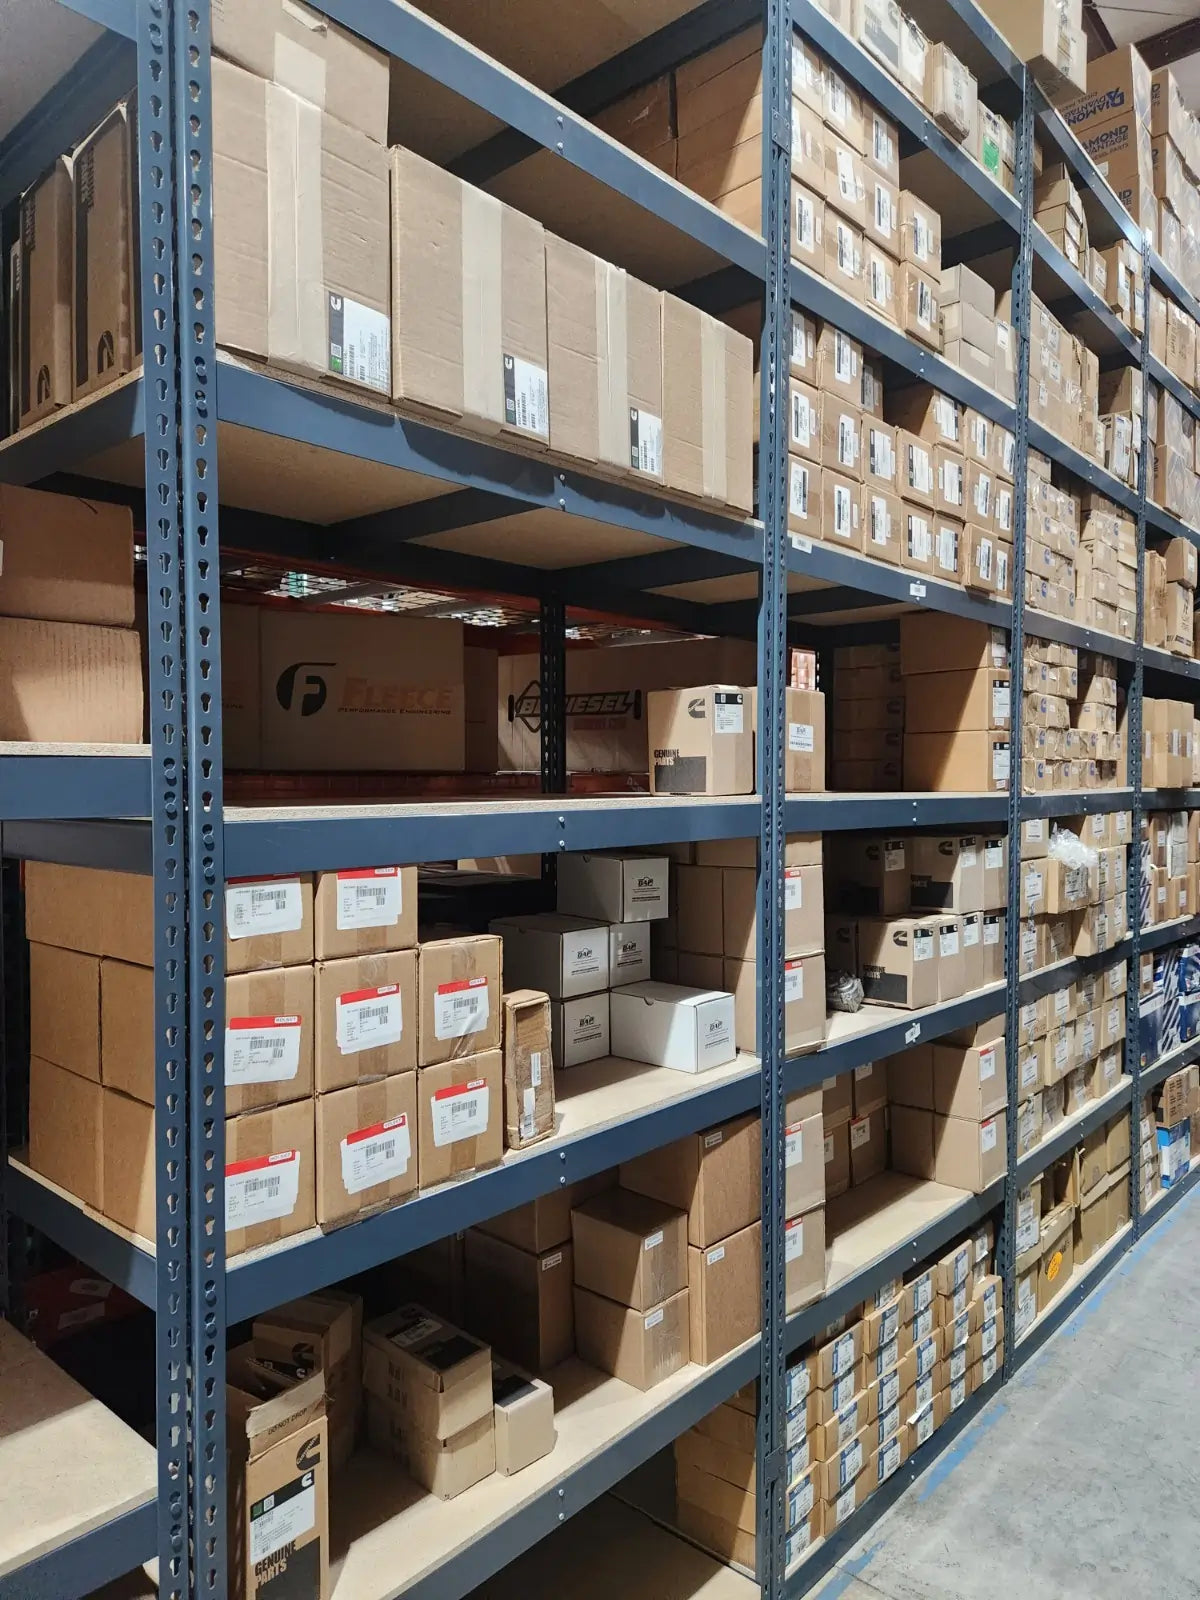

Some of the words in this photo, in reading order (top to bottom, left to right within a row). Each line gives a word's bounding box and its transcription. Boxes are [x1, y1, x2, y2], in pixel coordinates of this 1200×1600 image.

[1067, 87, 1124, 126] DIAMON
[1082, 124, 1129, 150] AMOND
[654, 748, 680, 759] GENUINE
[655, 756, 675, 766] PARTS
[255, 1540, 297, 1577] GENUINE
[256, 1558, 288, 1587] PARTS
